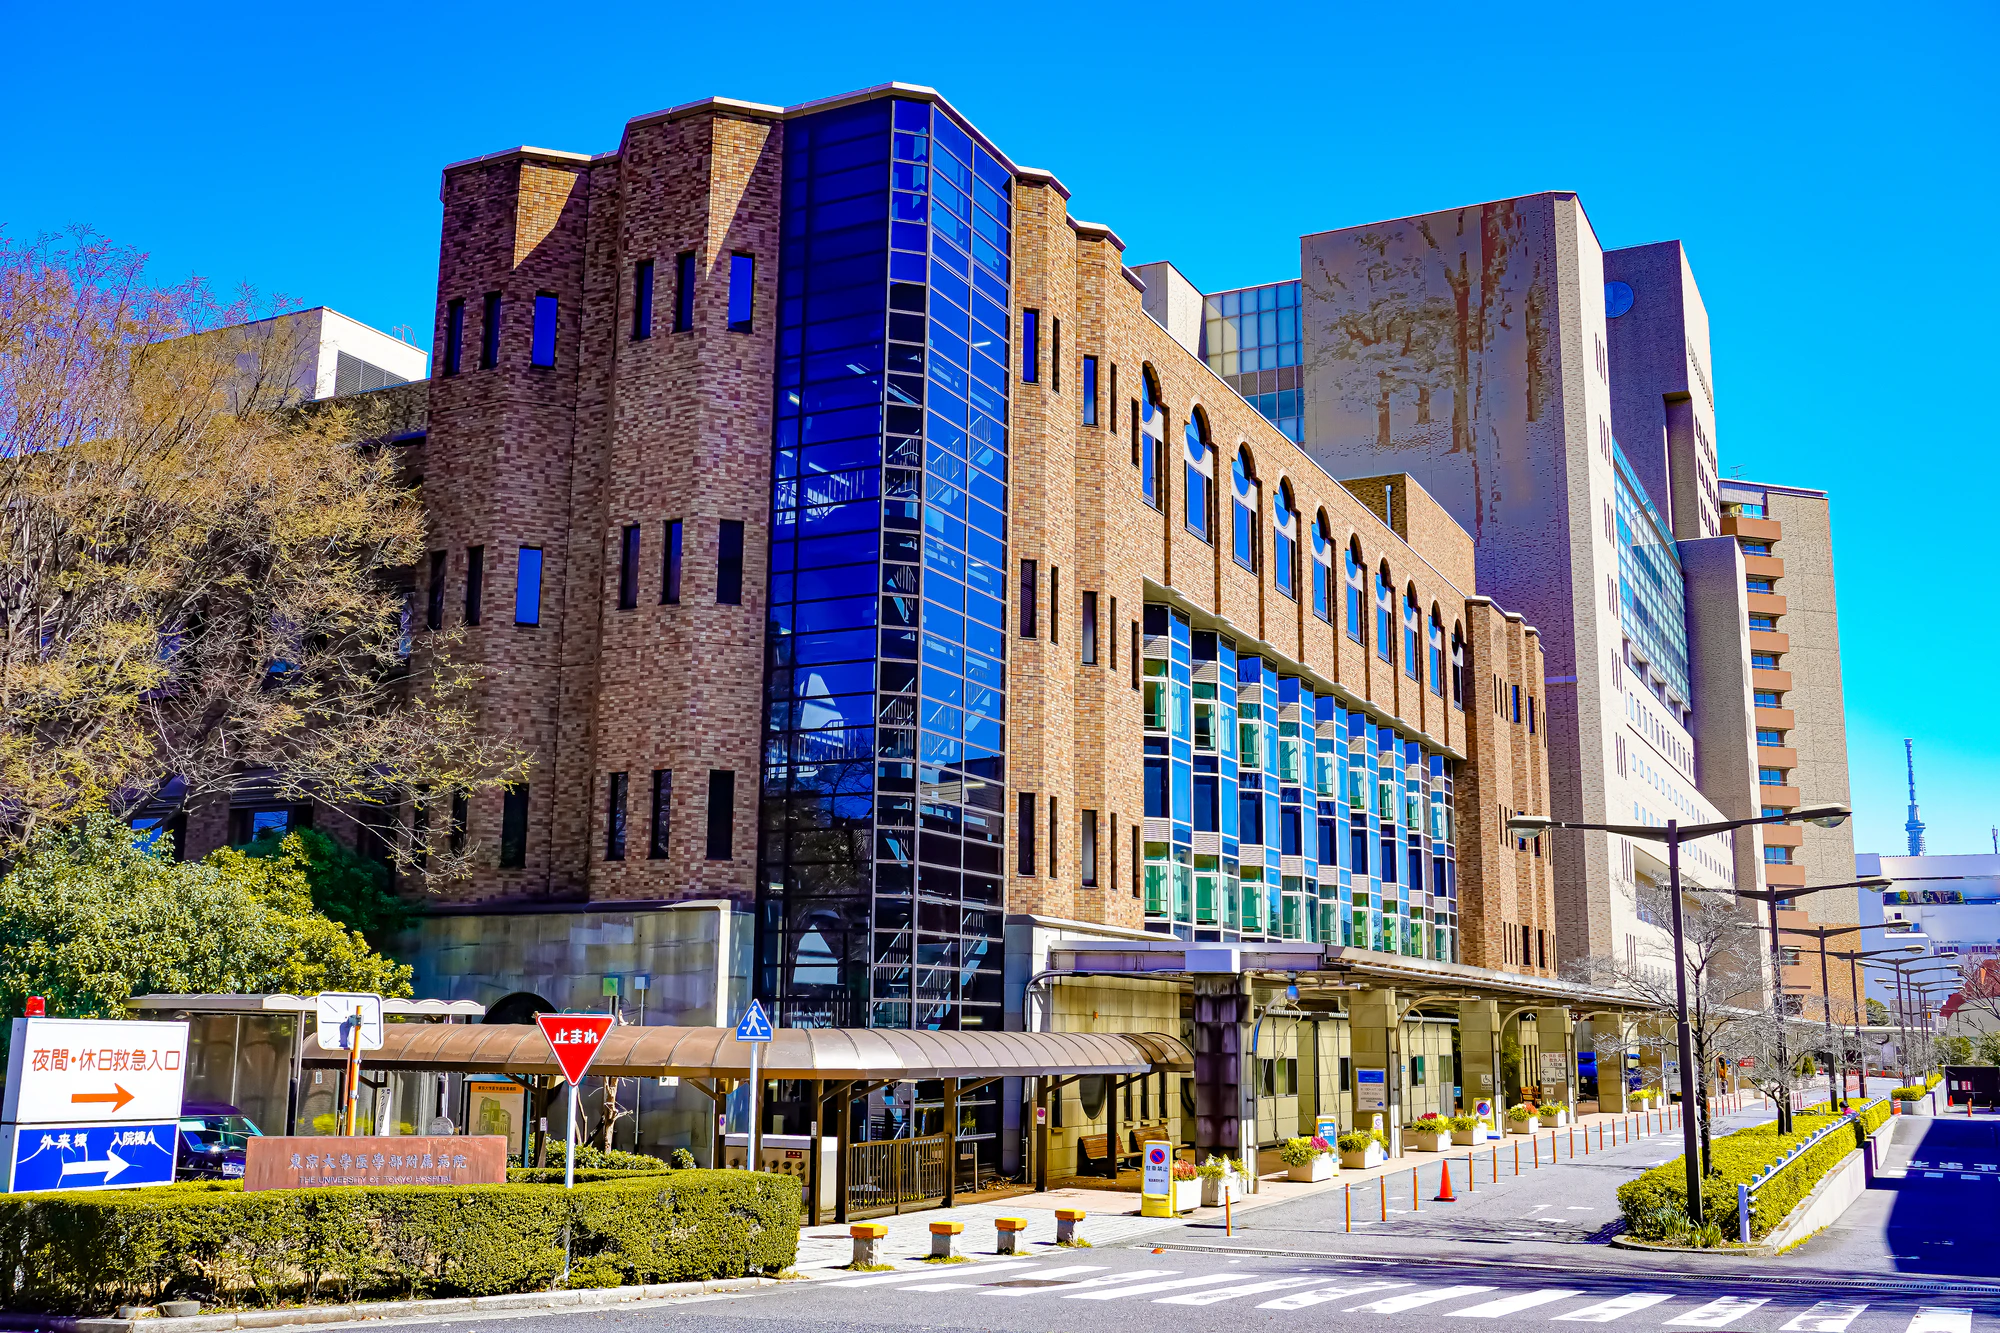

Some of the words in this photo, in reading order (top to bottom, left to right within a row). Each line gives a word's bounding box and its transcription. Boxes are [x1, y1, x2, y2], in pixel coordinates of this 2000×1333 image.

[553, 1028, 599, 1044] 止まれ
[32, 1048, 181, 1071] 夜間・休日救急入口
[40, 1133, 88, 1150] 外来棟
[113, 1131, 156, 1146] 入院棟A
[299, 1176, 316, 1184] THE
[318, 1175, 366, 1184] UNIVERSITY
[369, 1175, 380, 1183] OF
[384, 1175, 413, 1183] TOKYO
[415, 1174, 454, 1183] HOSPITAL
